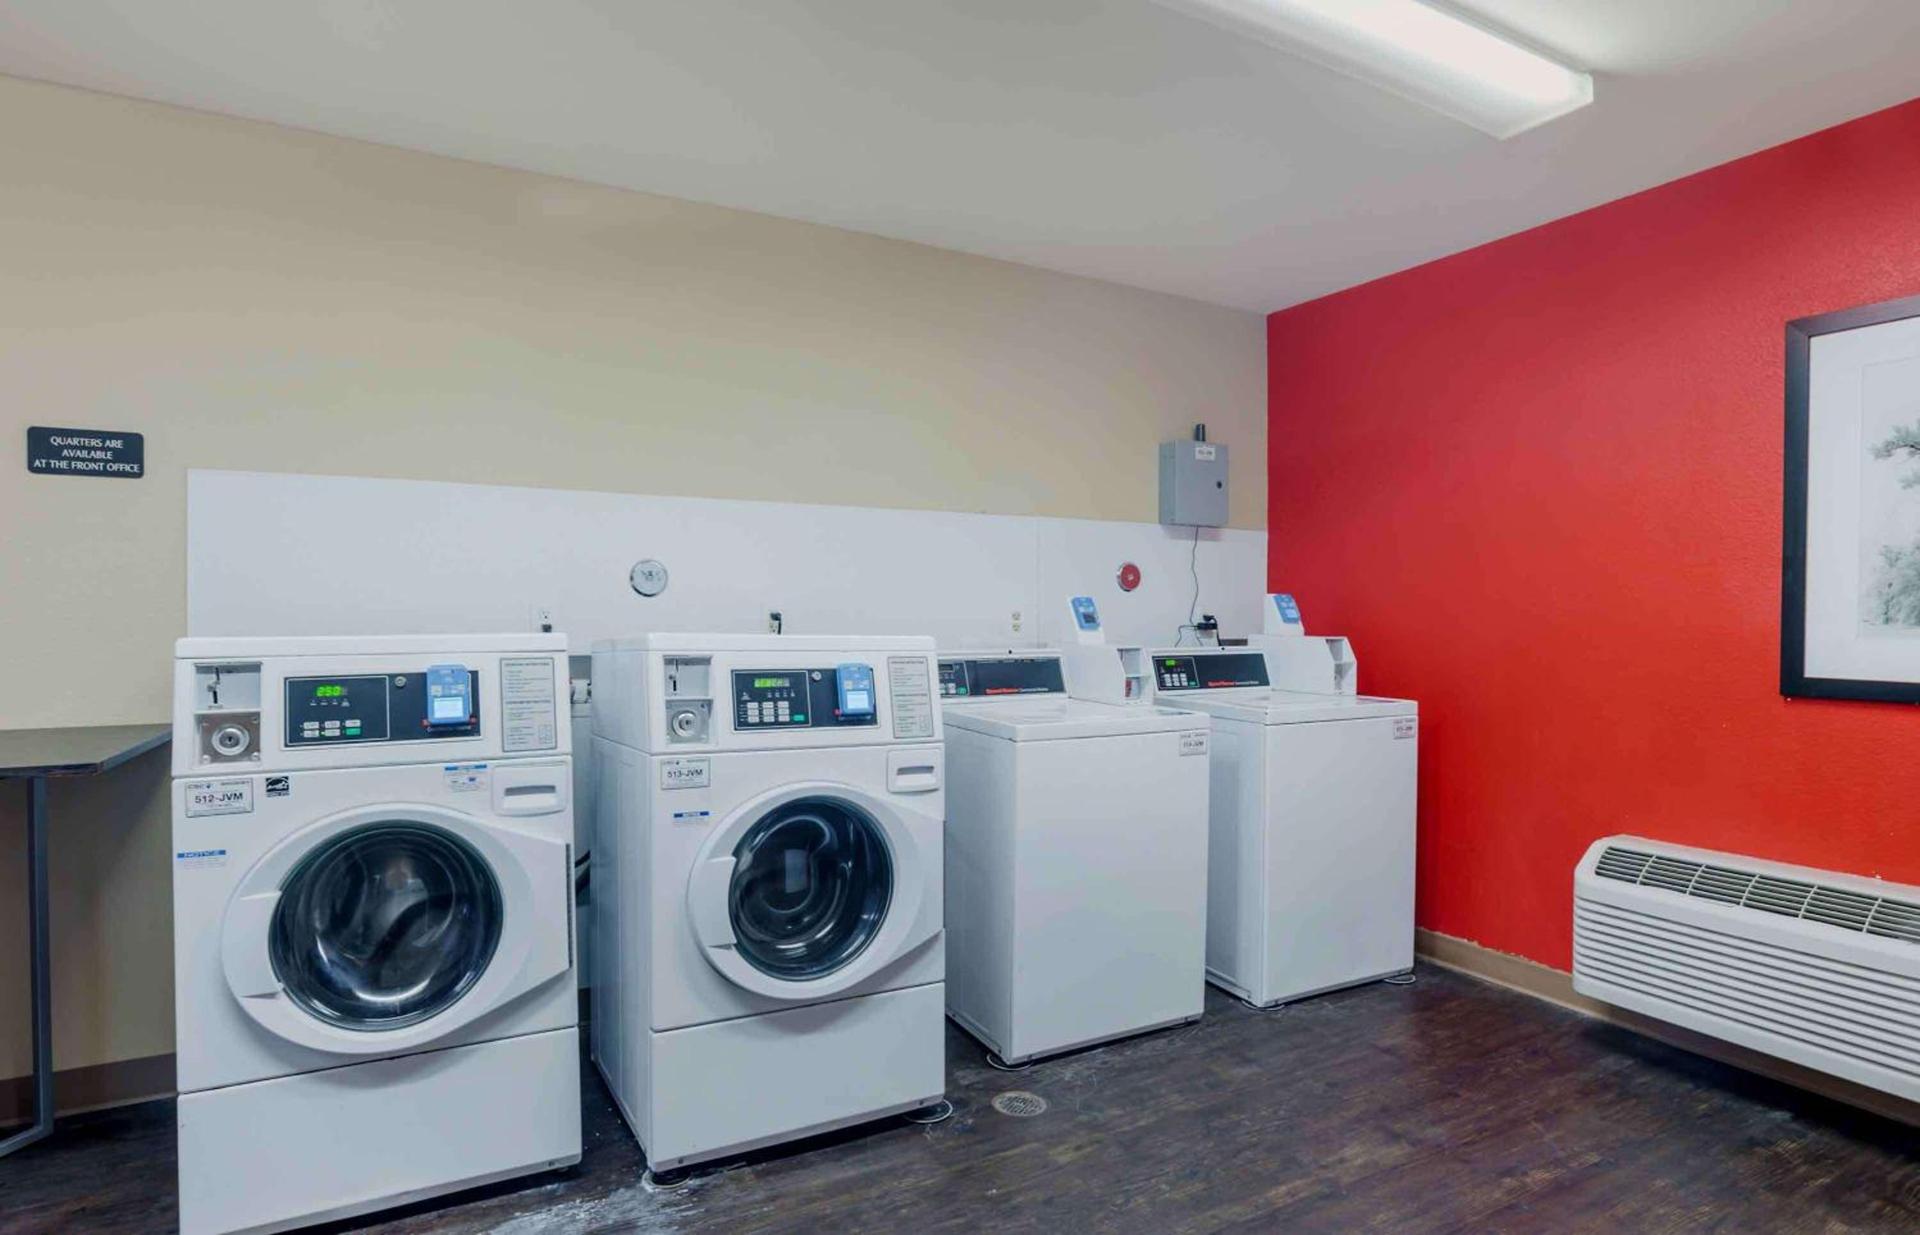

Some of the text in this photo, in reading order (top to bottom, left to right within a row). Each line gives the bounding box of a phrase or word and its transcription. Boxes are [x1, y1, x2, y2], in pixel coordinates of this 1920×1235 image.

[50, 436, 124, 448] QUARTERS ARE
[62, 449, 113, 460] AVAILABLE
[33, 459, 141, 473] AT THE FRONT OFFICE
[667, 768, 704, 778] 513-JVM
[194, 792, 243, 804] 512-JVM
